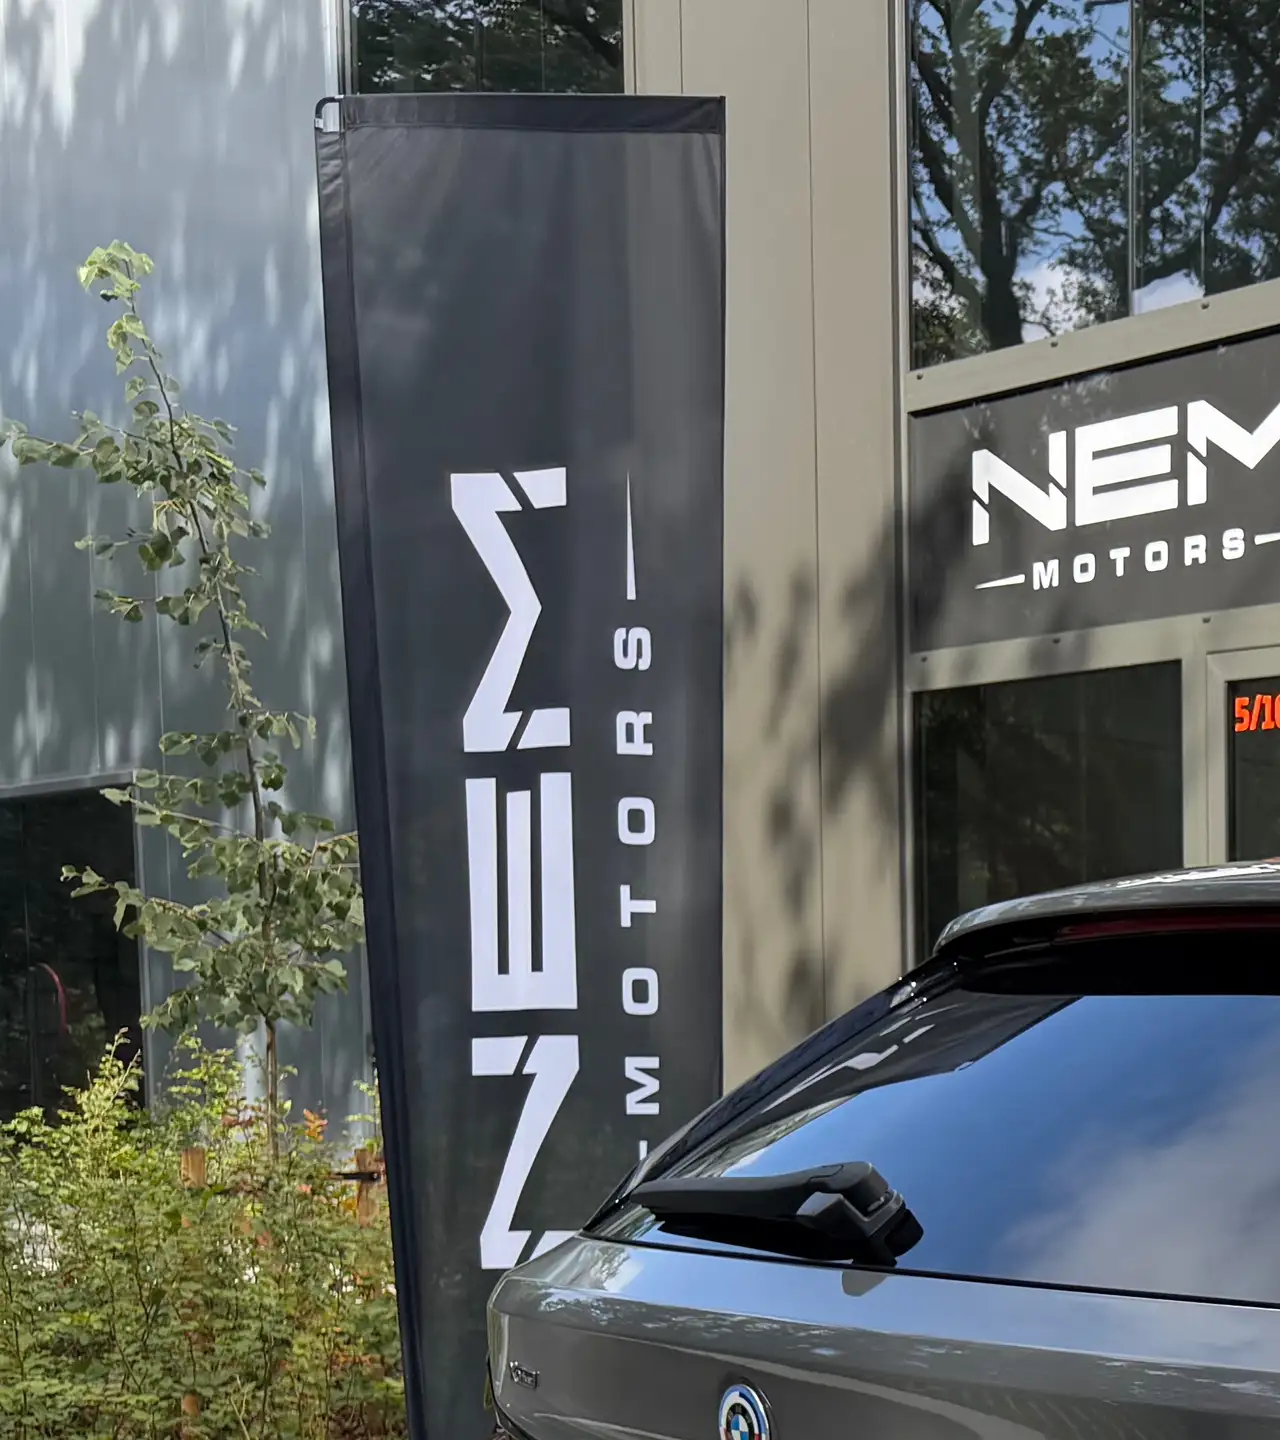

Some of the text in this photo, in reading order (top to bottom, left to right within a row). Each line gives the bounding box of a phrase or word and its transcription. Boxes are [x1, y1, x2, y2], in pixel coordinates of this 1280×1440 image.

[1032, 527, 1245, 591] MOTORS
[450, 467, 580, 1270] NEM
[613, 627, 661, 1115] MOTORS
